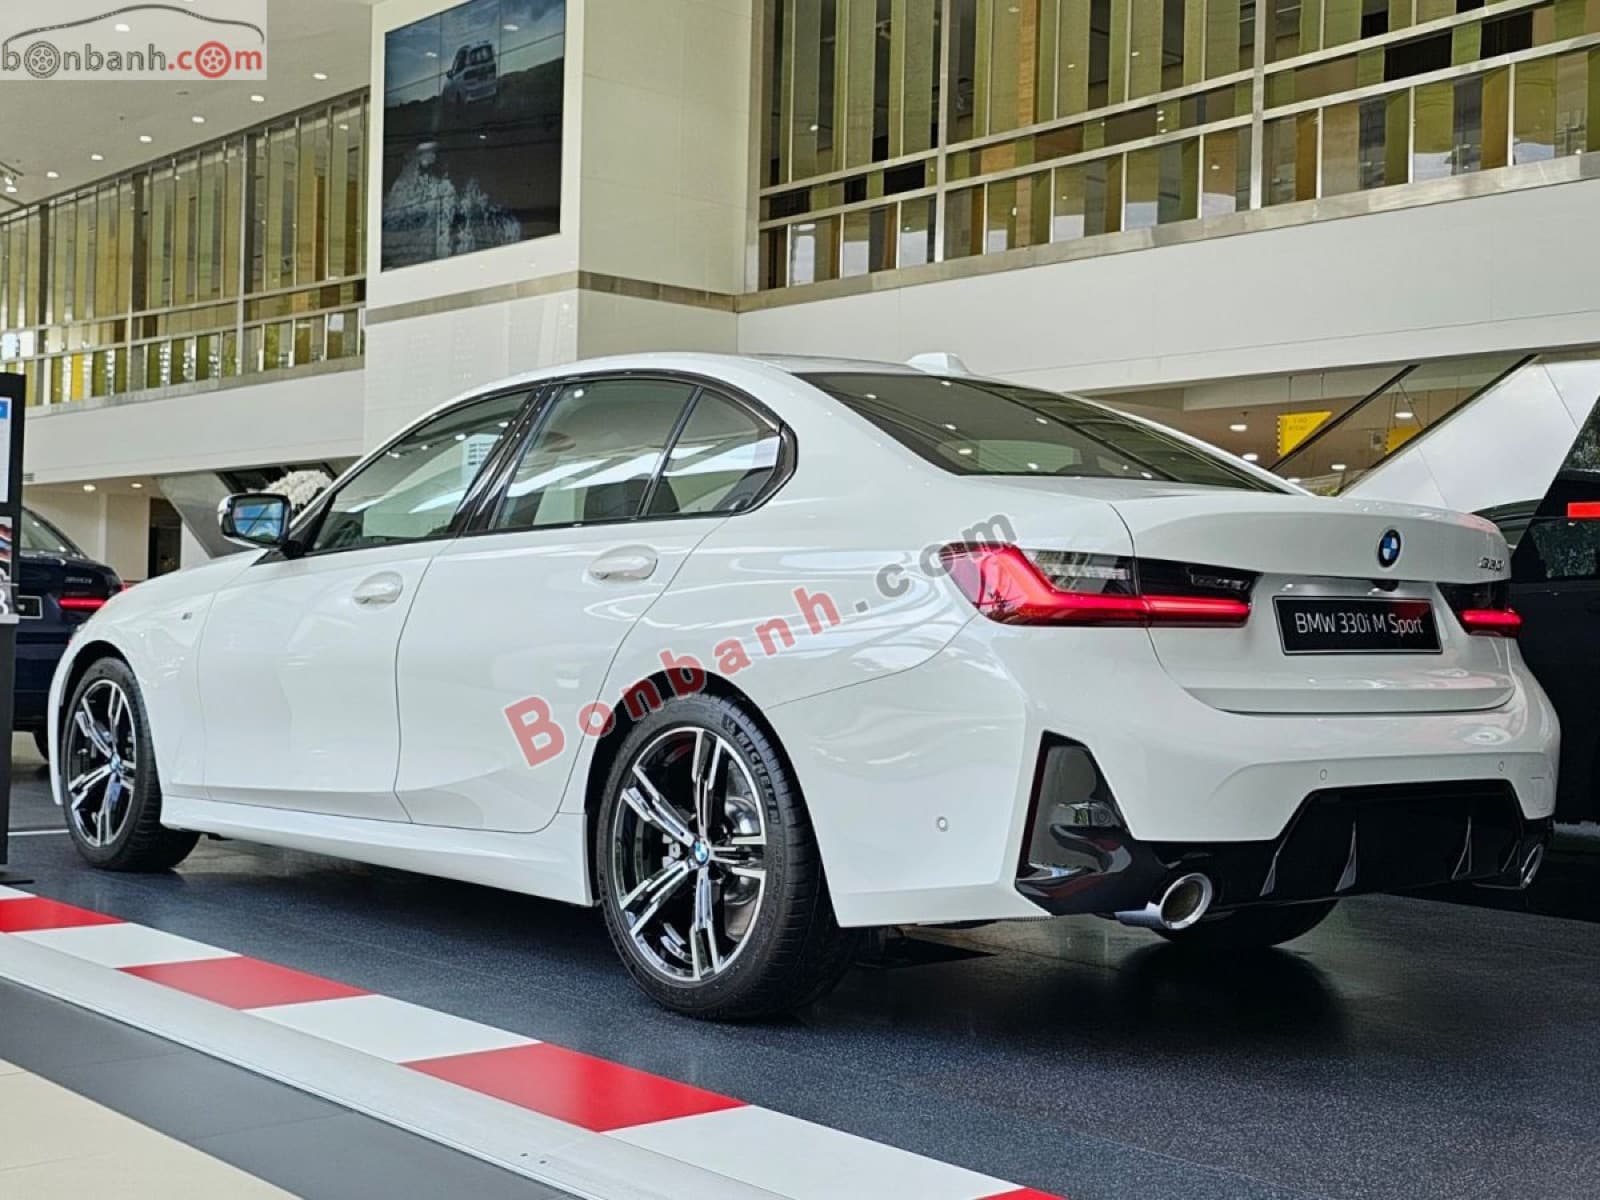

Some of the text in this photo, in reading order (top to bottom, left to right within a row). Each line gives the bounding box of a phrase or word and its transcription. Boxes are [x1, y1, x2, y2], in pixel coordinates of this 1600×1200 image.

[1295, 612, 1424, 637] BMW 330i M Sport
[736, 731, 780, 824] MICHELIN
